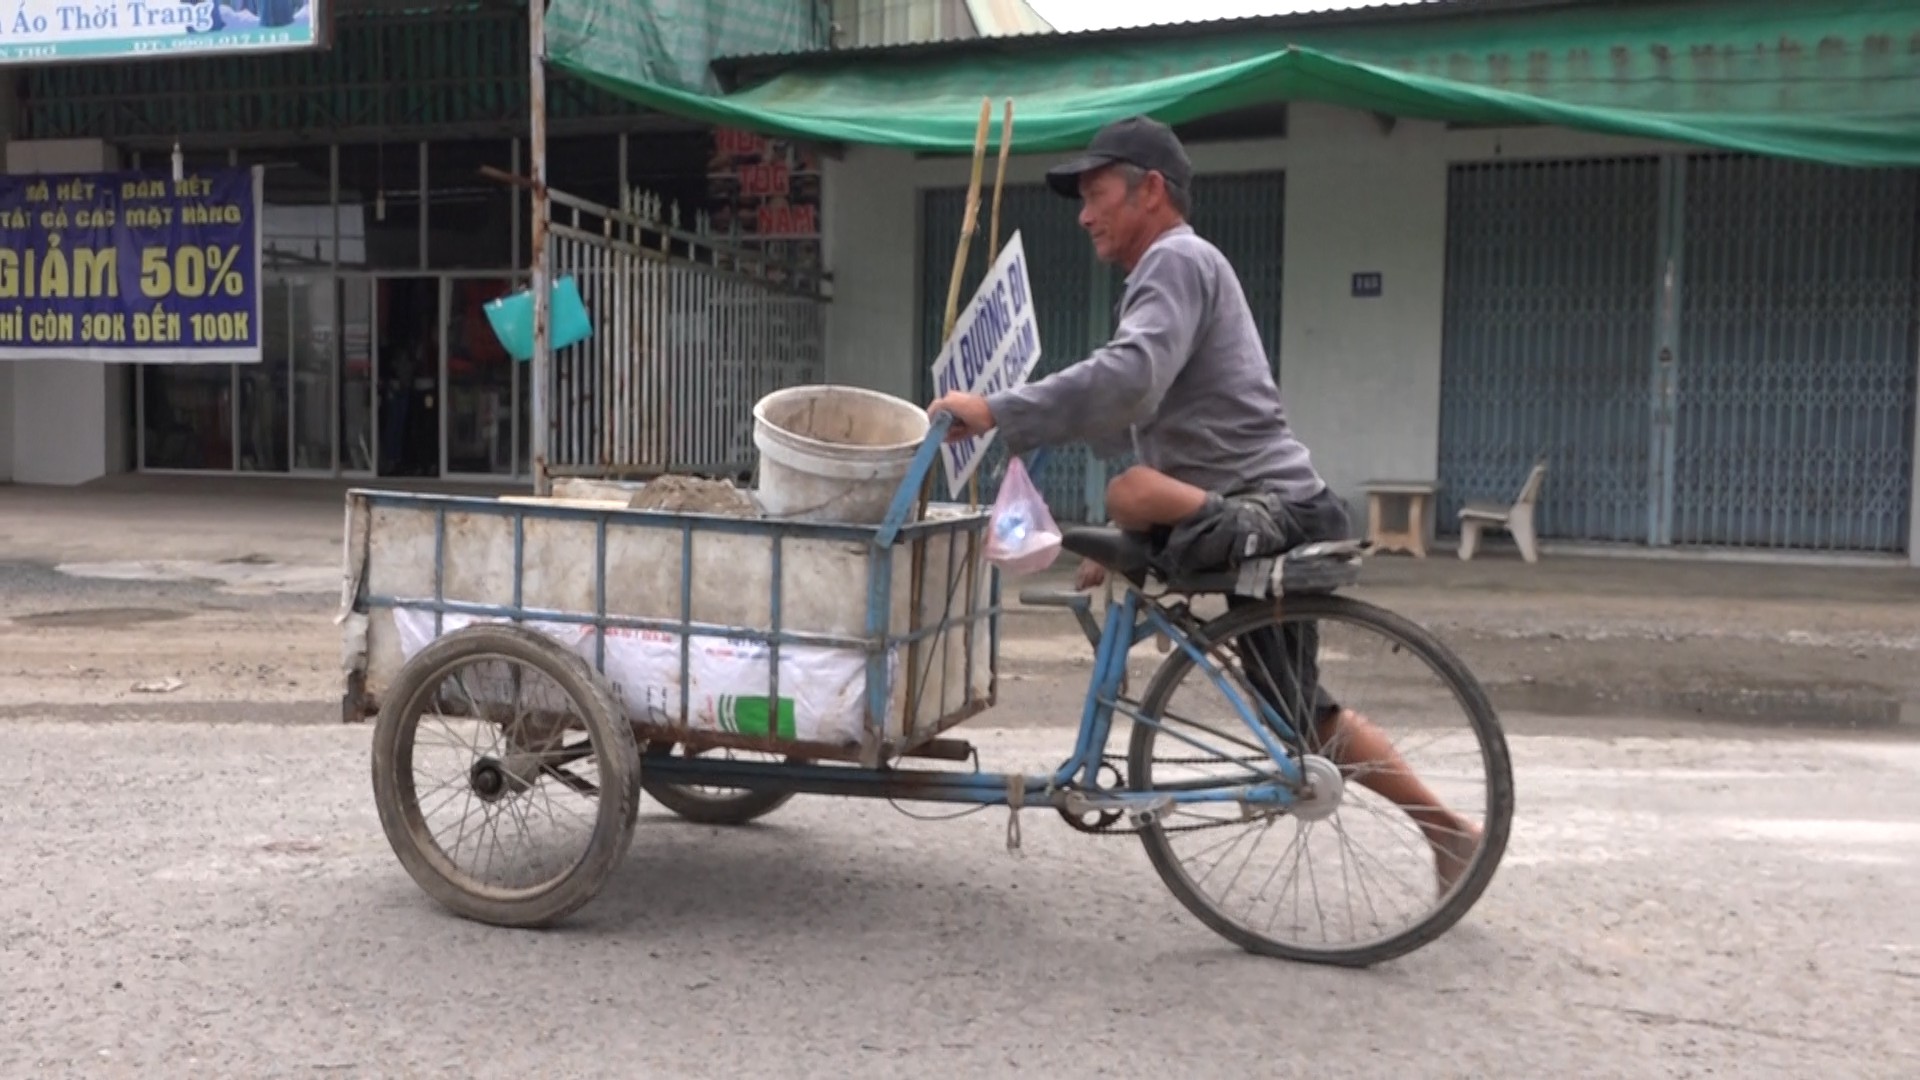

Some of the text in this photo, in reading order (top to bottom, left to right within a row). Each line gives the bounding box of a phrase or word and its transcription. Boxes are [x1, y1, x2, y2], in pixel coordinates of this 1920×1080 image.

[12, 0, 48, 33] Áo
[56, 4, 118, 31] Thời
[127, 0, 212, 28] Trang
[57, 177, 95, 201] HẾT
[75, 208, 115, 229] CÁC
[182, 203, 241, 224] HÀNG
[0, 233, 244, 298] GIẢM 50%
[1008, 254, 1027, 316] ĐI
[29, 307, 73, 342] CÒN
[81, 312, 126, 342] 30K
[132, 302, 181, 342] ĐẾN
[190, 311, 249, 342] 100K
